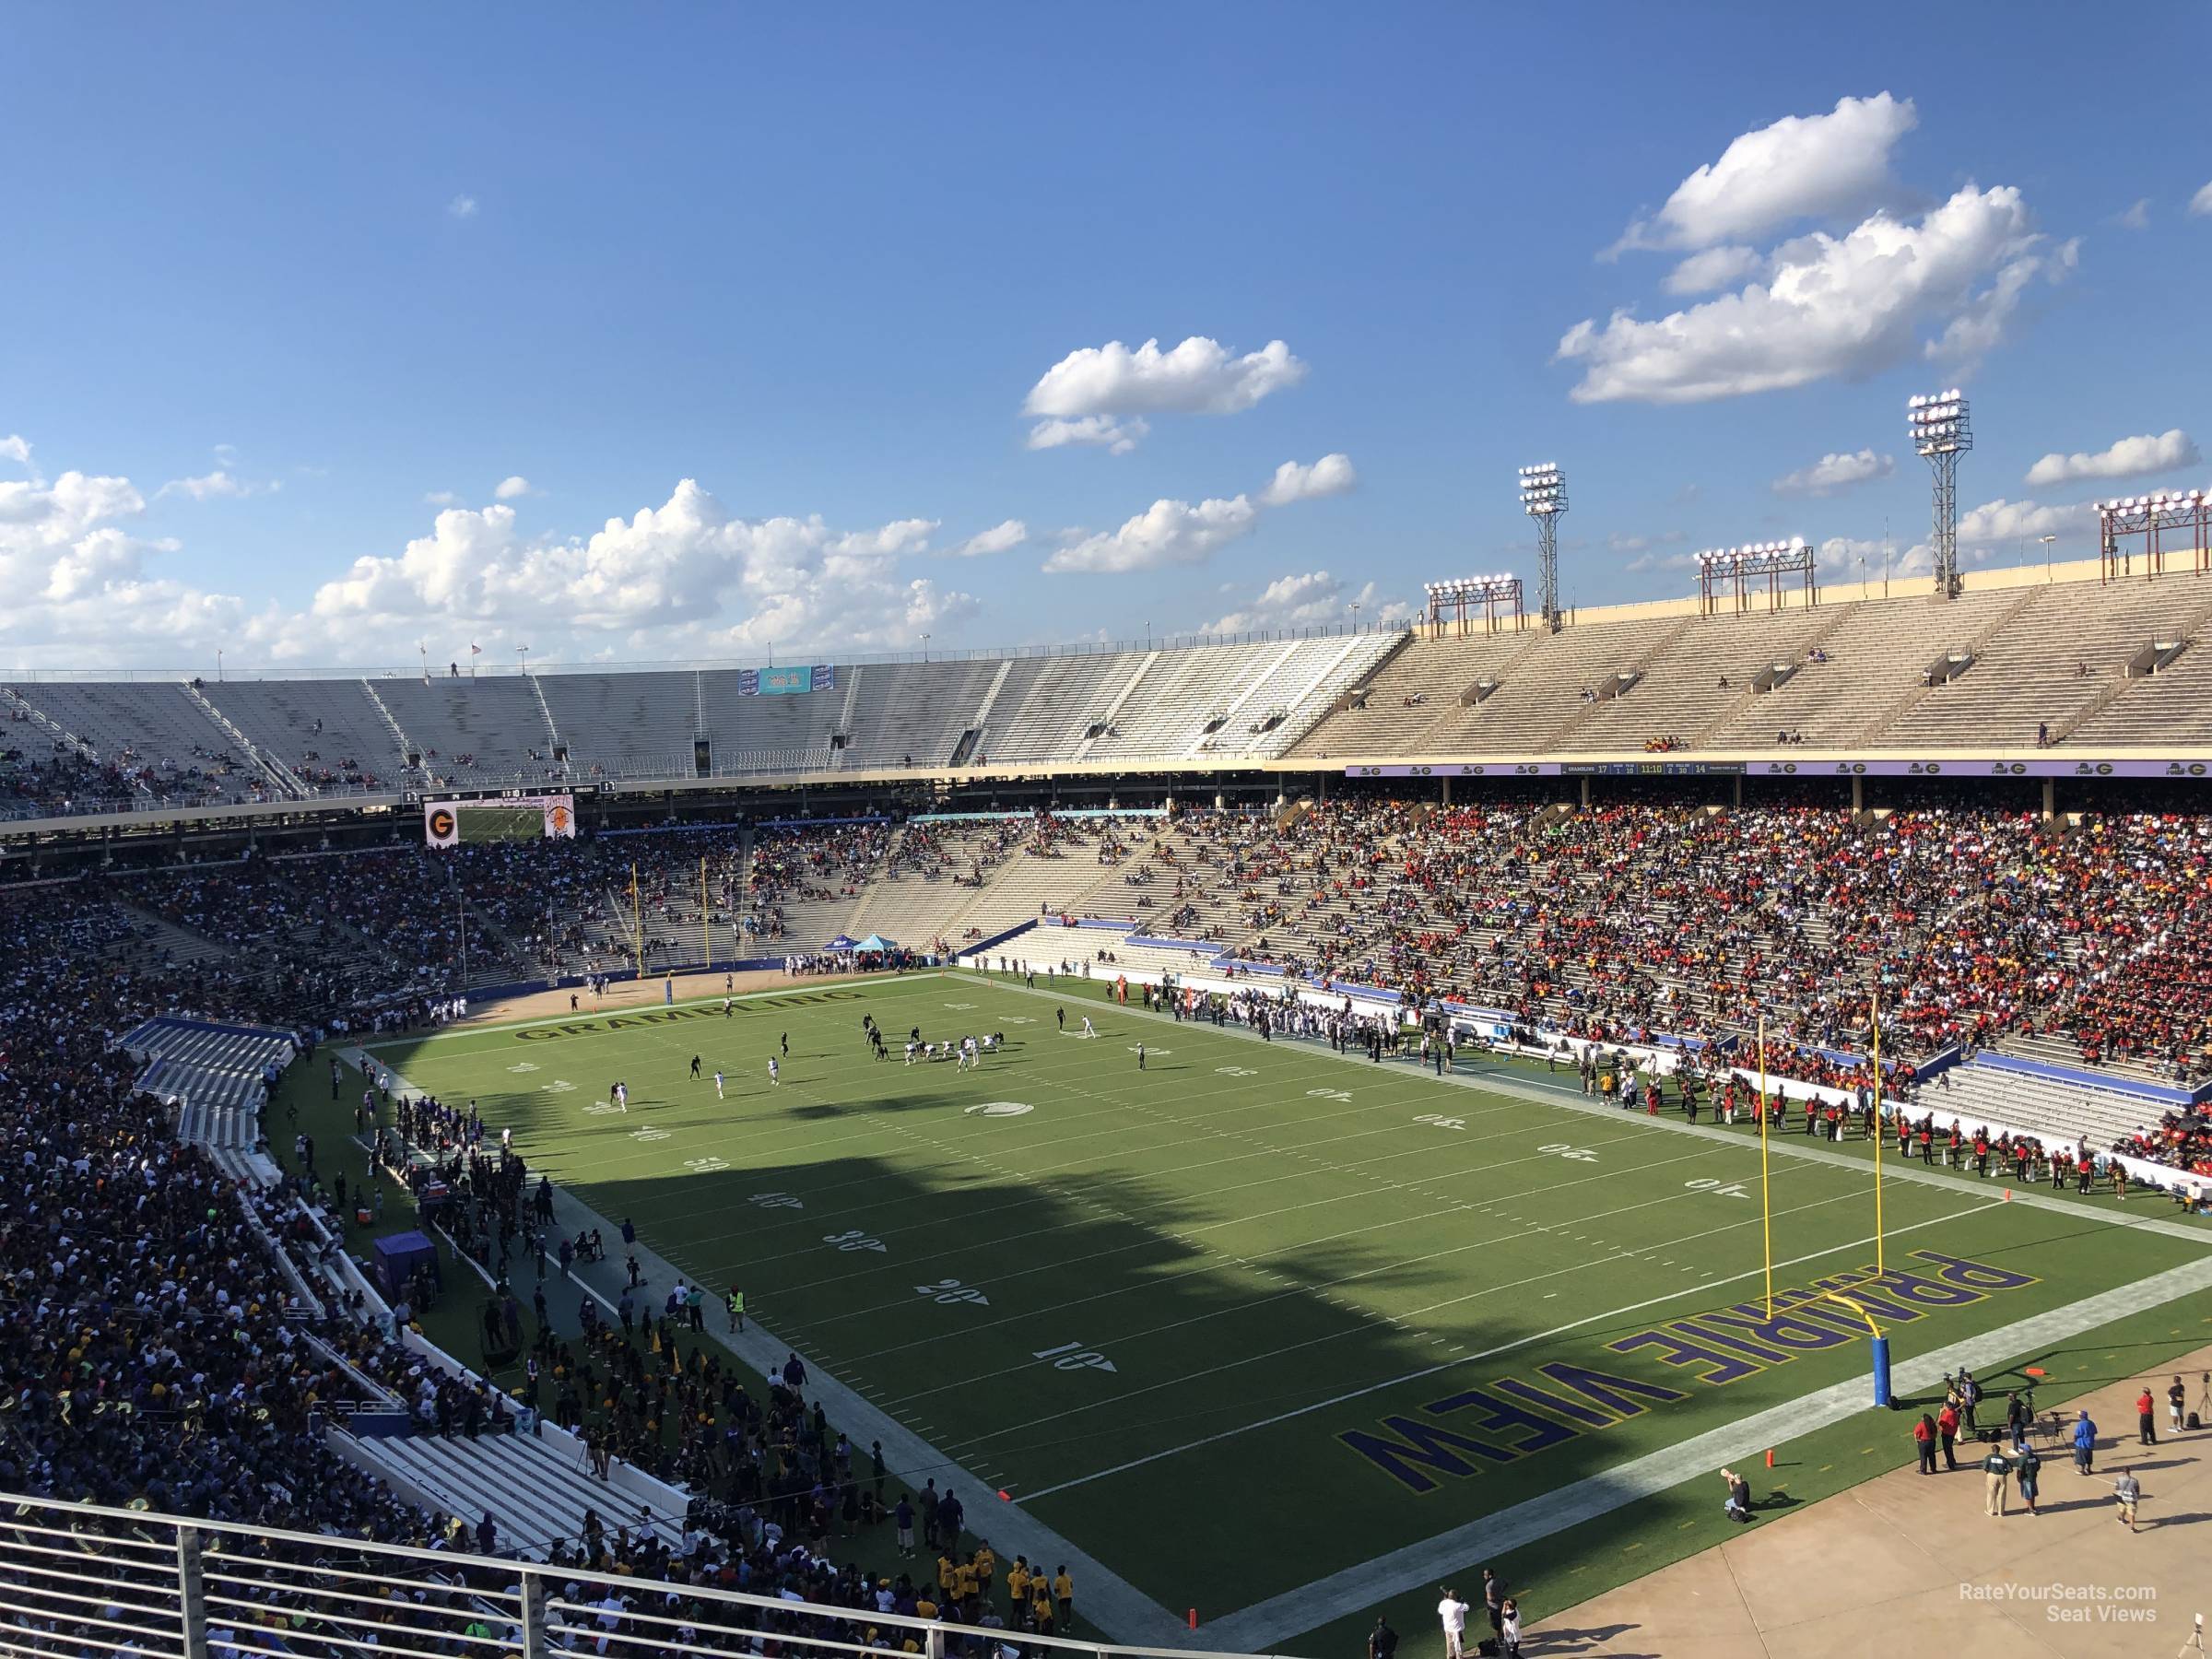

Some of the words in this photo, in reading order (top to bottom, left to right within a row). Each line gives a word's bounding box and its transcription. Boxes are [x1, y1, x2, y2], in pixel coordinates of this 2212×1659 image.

[1598, 765, 1607, 773] 17
[1641, 765, 1662, 773] 11:10
[1696, 764, 1706, 773] 14
[605, 781, 615, 791] 17
[406, 792, 418, 802] 17
[429, 808, 454, 841] G
[515, 992, 868, 1041] GRAMBLING
[1214, 1066, 1259, 1077] 50
[1306, 1088, 1352, 1100] 40
[1412, 1112, 1465, 1128] 30
[1536, 1143, 1600, 1160] 20
[684, 1156, 731, 1171] 50
[1684, 1178, 1748, 1197] 10
[747, 1192, 799, 1208] 40
[823, 1230, 881, 1252] 30
[913, 1278, 982, 1305] 20
[1602, 1249, 2043, 1387] PRAIRIE
[1032, 1341, 1107, 1371] 10
[1333, 1361, 1694, 1496] VIEW
